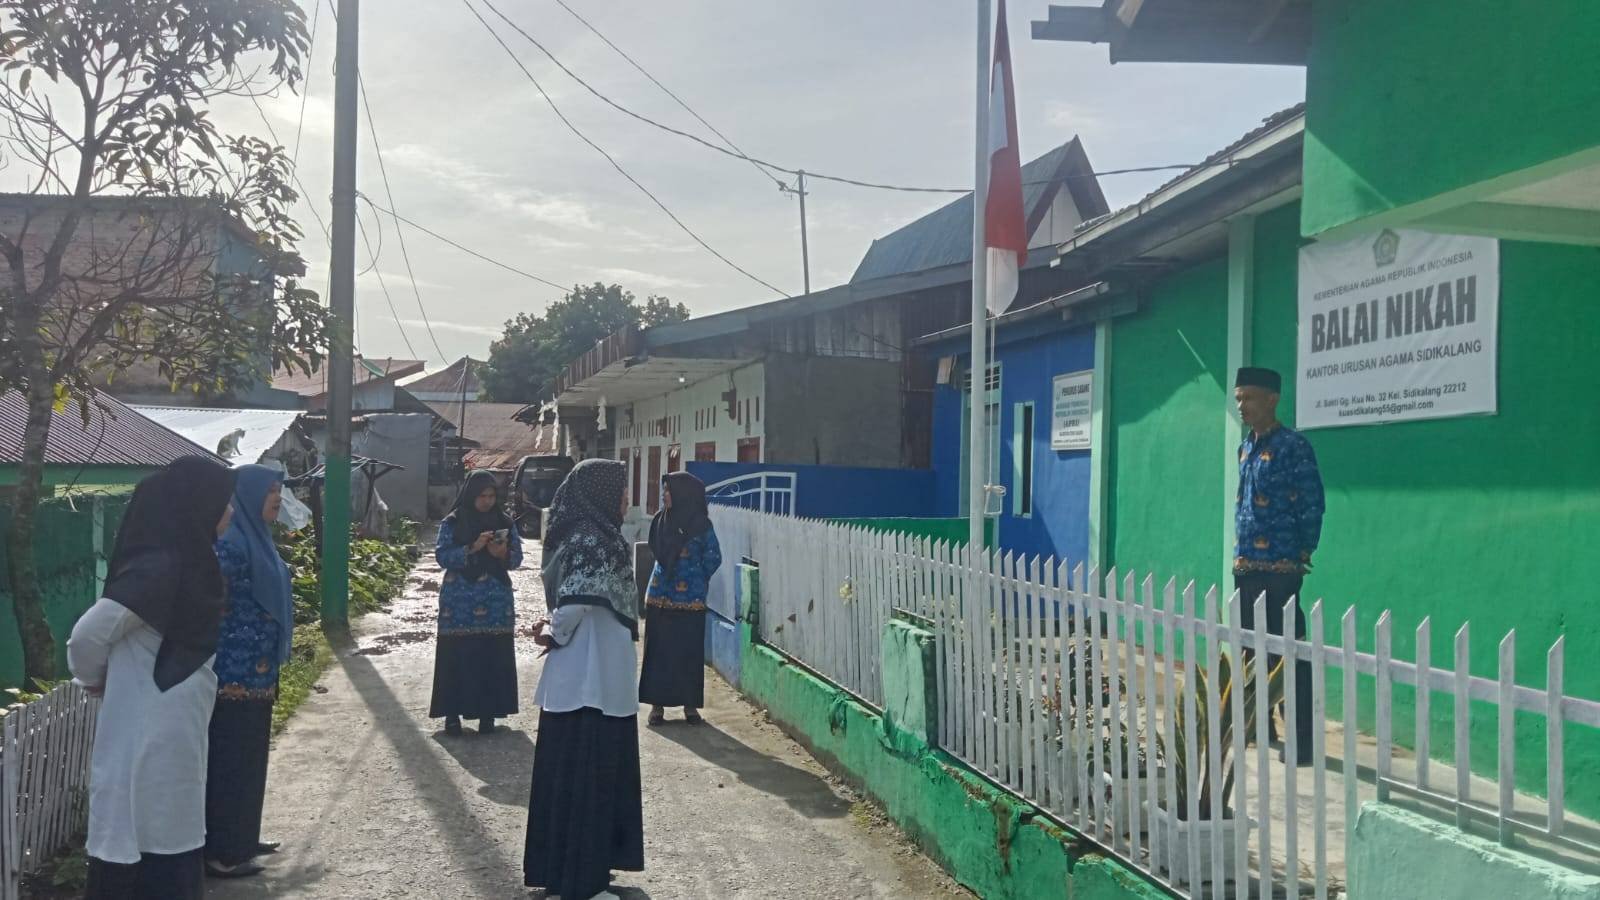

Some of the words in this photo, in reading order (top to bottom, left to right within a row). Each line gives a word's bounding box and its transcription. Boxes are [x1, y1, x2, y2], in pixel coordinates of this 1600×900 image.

[1313, 283, 1359, 301] KEMENTERIAN
[1360, 275, 1386, 289] AGAMA
[1388, 265, 1427, 282] REPUBLIK
[1428, 250, 1473, 270] INDONESIA
[1311, 299, 1379, 353] BALAI
[1385, 275, 1477, 339] NIKAH
[1306, 363, 1339, 380] KANTOR
[1341, 358, 1377, 375] URUSAN
[1378, 351, 1414, 368] AGAMA
[1416, 339, 1482, 362] SIDIKALANG
[1338, 400, 1434, 417] kuasidikalang55@gmail.com
[1352, 395, 1364, 405] Kua
[1378, 392, 1386, 402] 32
[1403, 386, 1441, 399] Sidikalang
[1443, 382, 1467, 394] 22212
